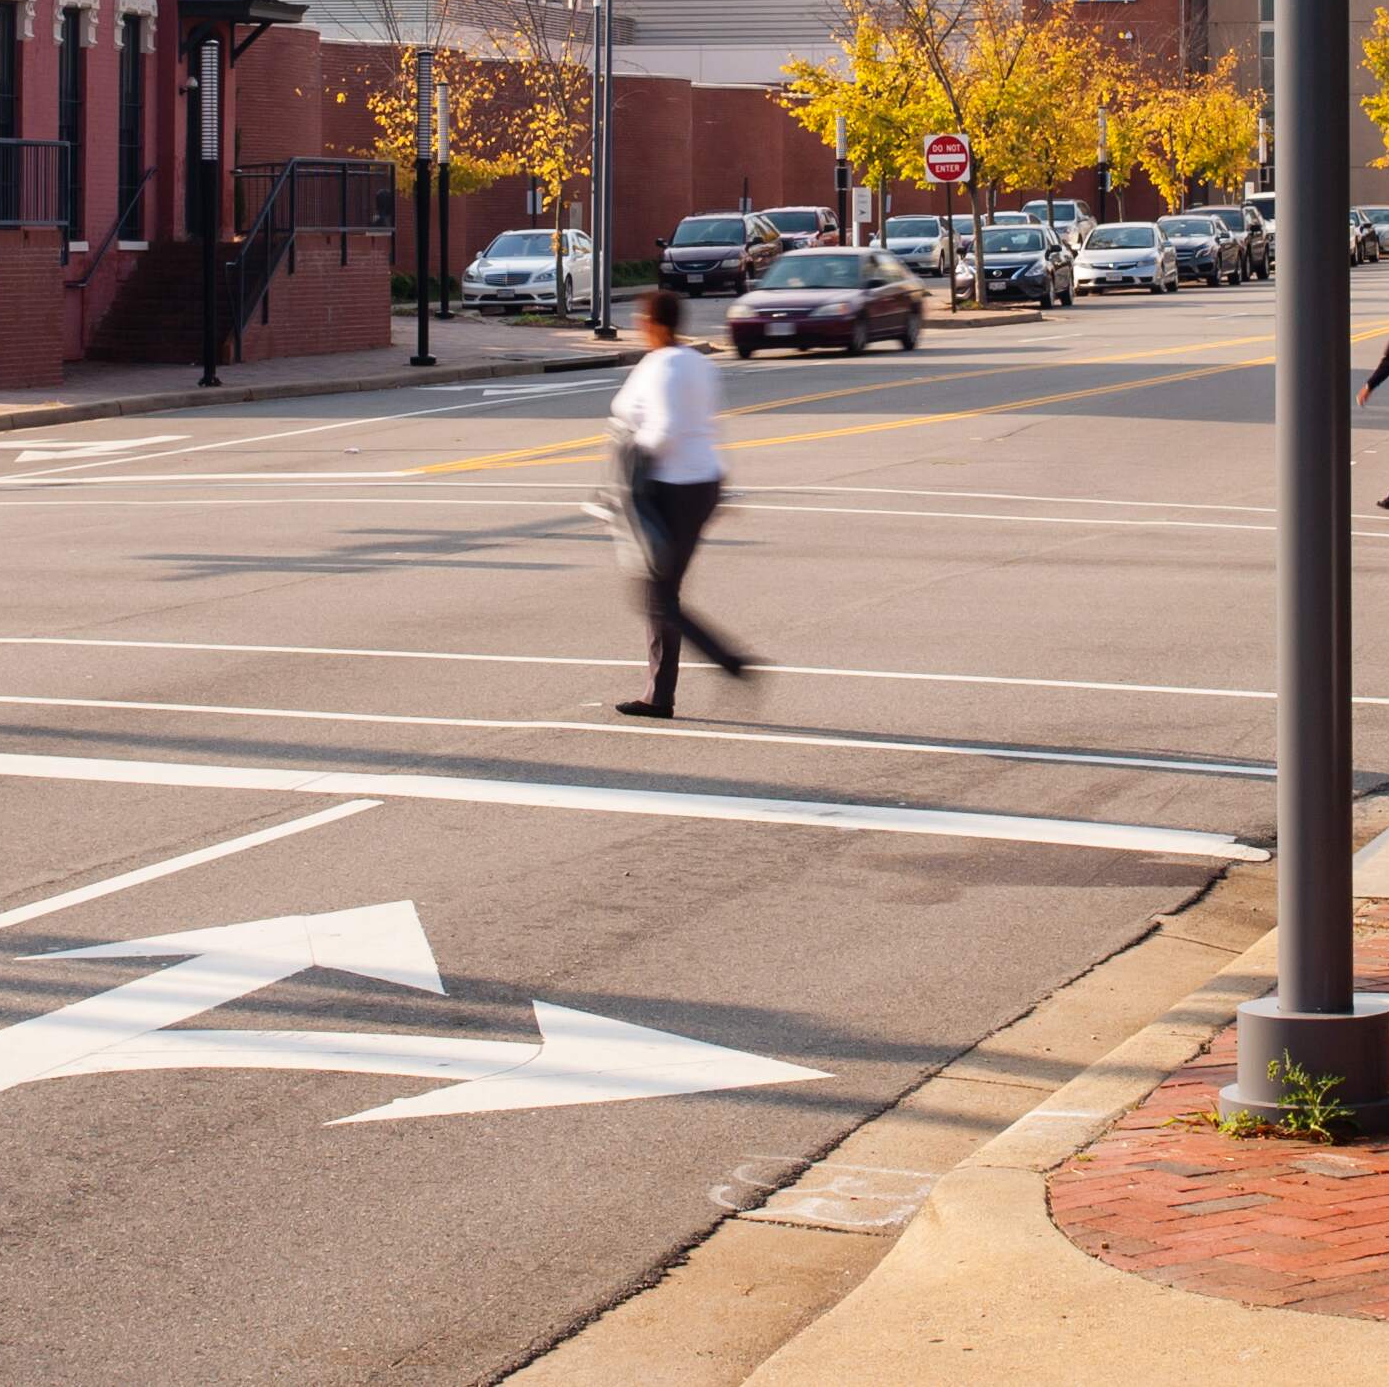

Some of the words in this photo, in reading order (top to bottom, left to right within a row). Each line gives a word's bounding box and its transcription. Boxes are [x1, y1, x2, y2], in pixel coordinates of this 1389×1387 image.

[932, 144, 943, 153] DO
[946, 143, 961, 152] NOT
[935, 164, 960, 173] ENTER
